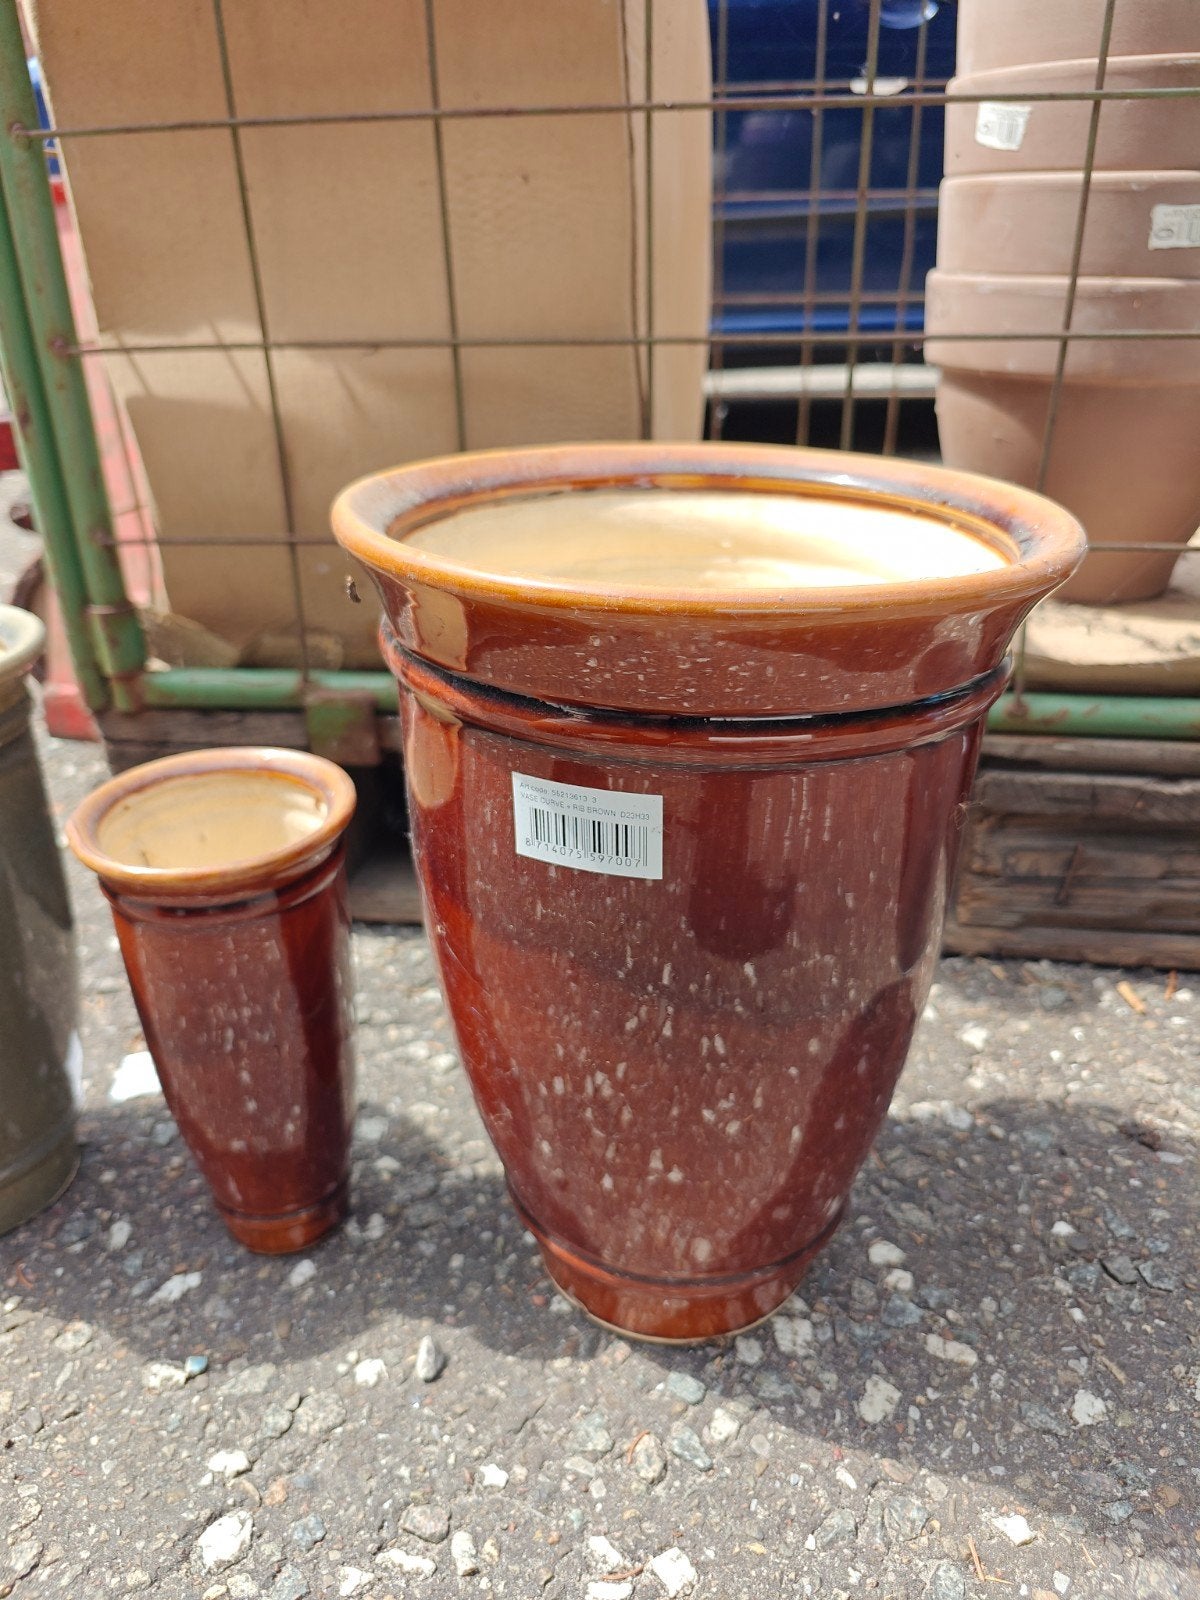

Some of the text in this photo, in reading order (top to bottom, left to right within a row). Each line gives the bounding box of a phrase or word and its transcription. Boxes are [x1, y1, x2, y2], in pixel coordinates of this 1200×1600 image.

[520, 791, 538, 803] VASE
[540, 797, 564, 809] CURVE
[587, 806, 616, 817] BROWN
[620, 810, 650, 821] D23H33
